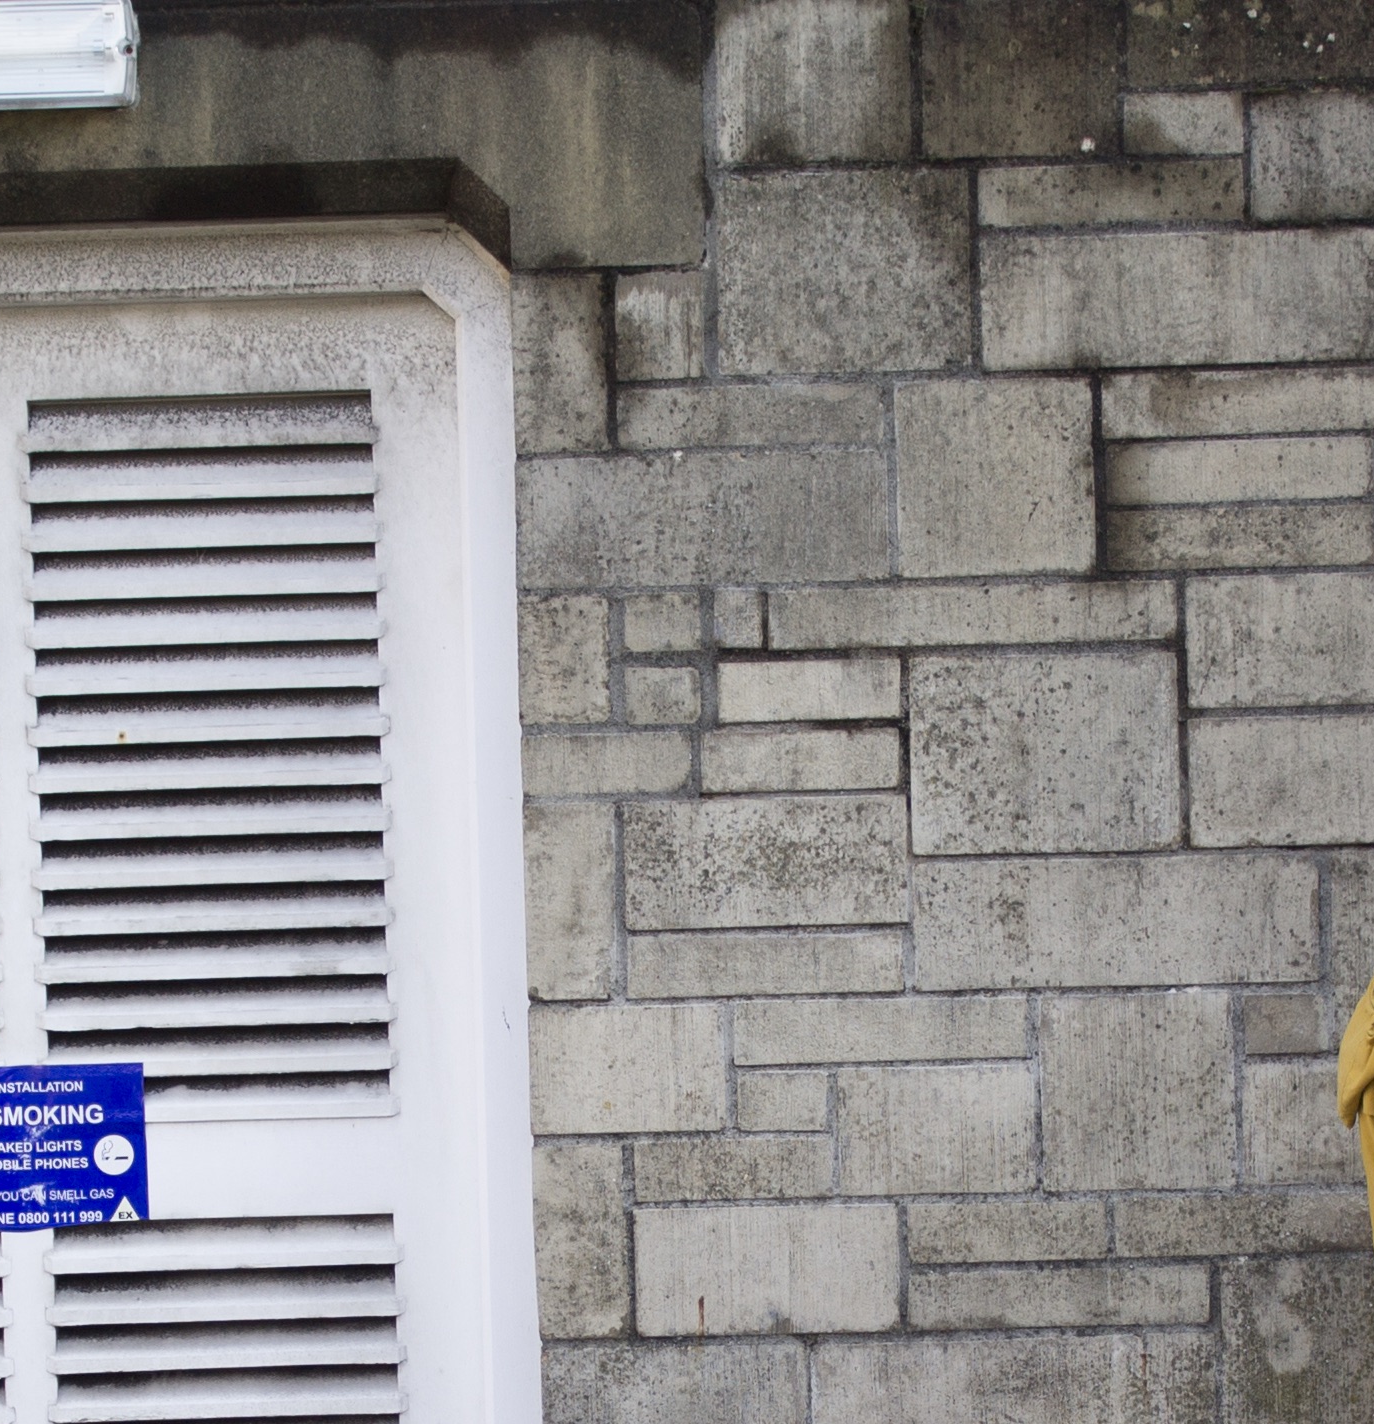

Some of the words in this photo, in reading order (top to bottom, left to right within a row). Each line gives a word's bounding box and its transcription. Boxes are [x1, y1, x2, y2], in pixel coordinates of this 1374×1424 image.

[35, 1140, 82, 1152] LIGHTS
[35, 1157, 89, 1170] PHONES
[21, 1189, 46, 1201] CAN
[49, 1188, 87, 1200] SMELL
[89, 1188, 114, 1200] GAS
[18, 1211, 50, 1224] 0800
[53, 1211, 75, 1223] 111
[79, 1210, 103, 1223] 999
[118, 1211, 133, 1220] EX
